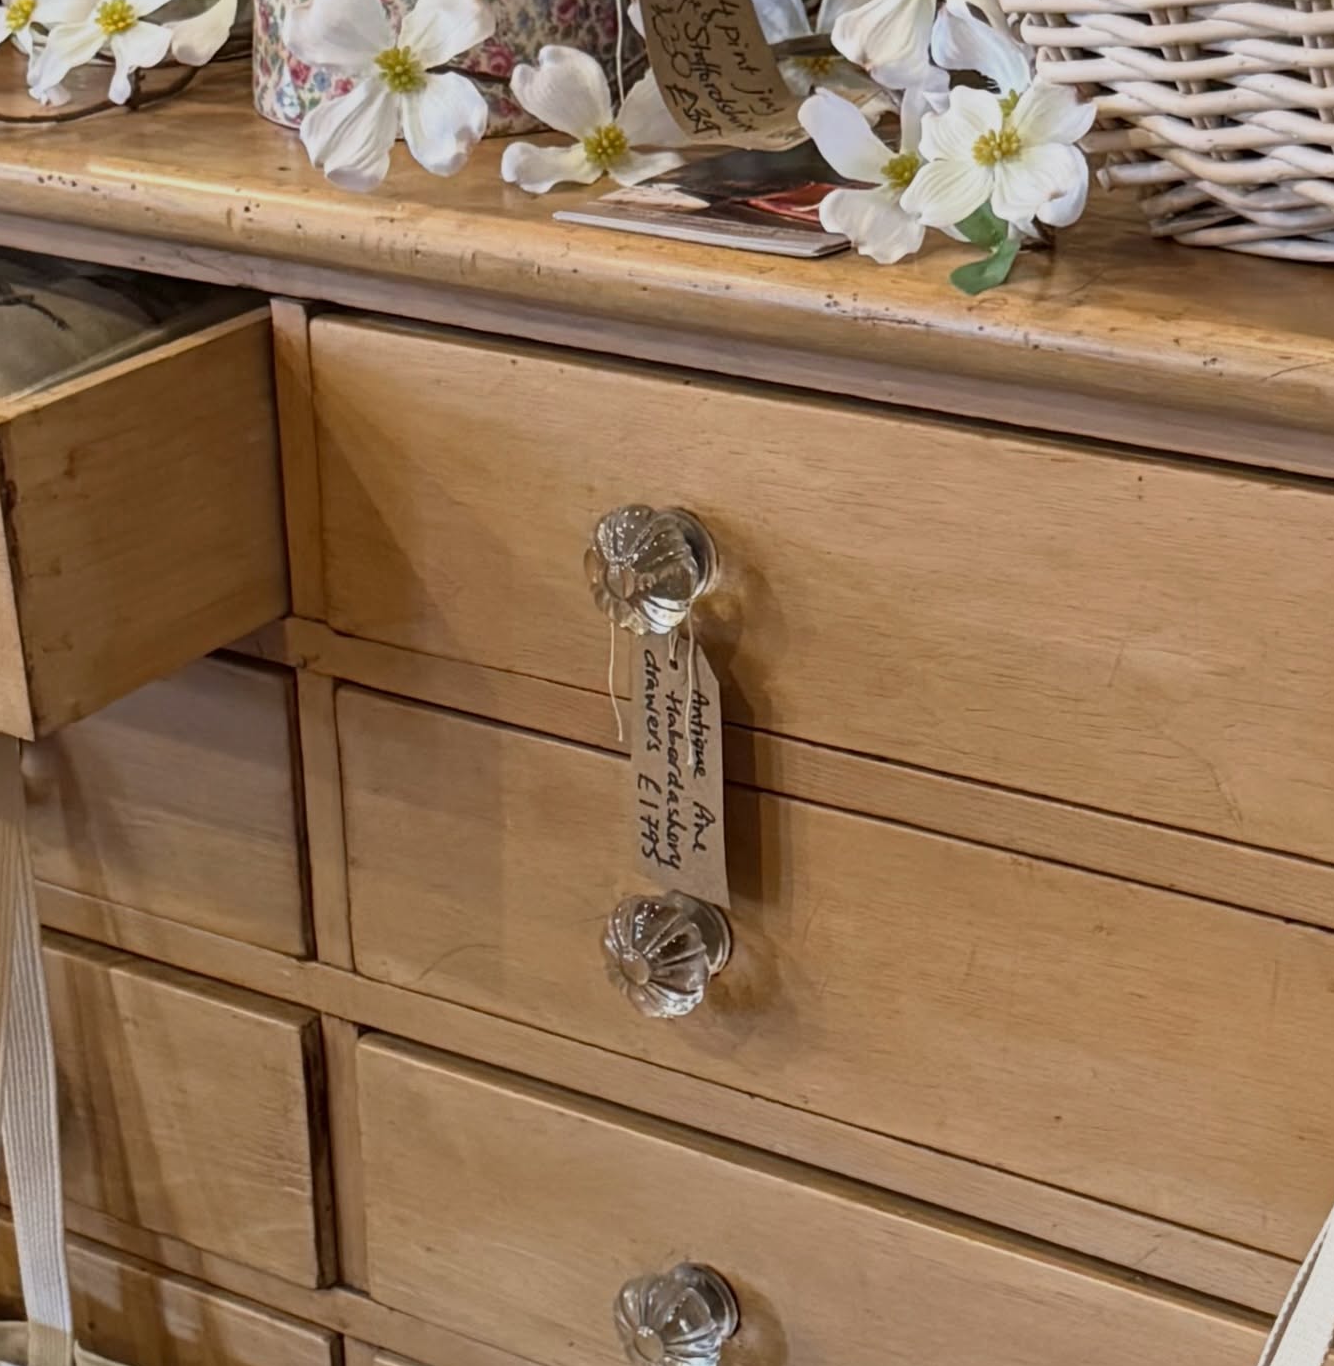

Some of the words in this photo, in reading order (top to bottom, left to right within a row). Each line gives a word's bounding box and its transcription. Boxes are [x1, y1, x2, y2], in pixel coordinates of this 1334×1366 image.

[720, 25, 762, 76] pint
[642, 649, 662, 753] drawers
[691, 689, 711, 780] Antique
